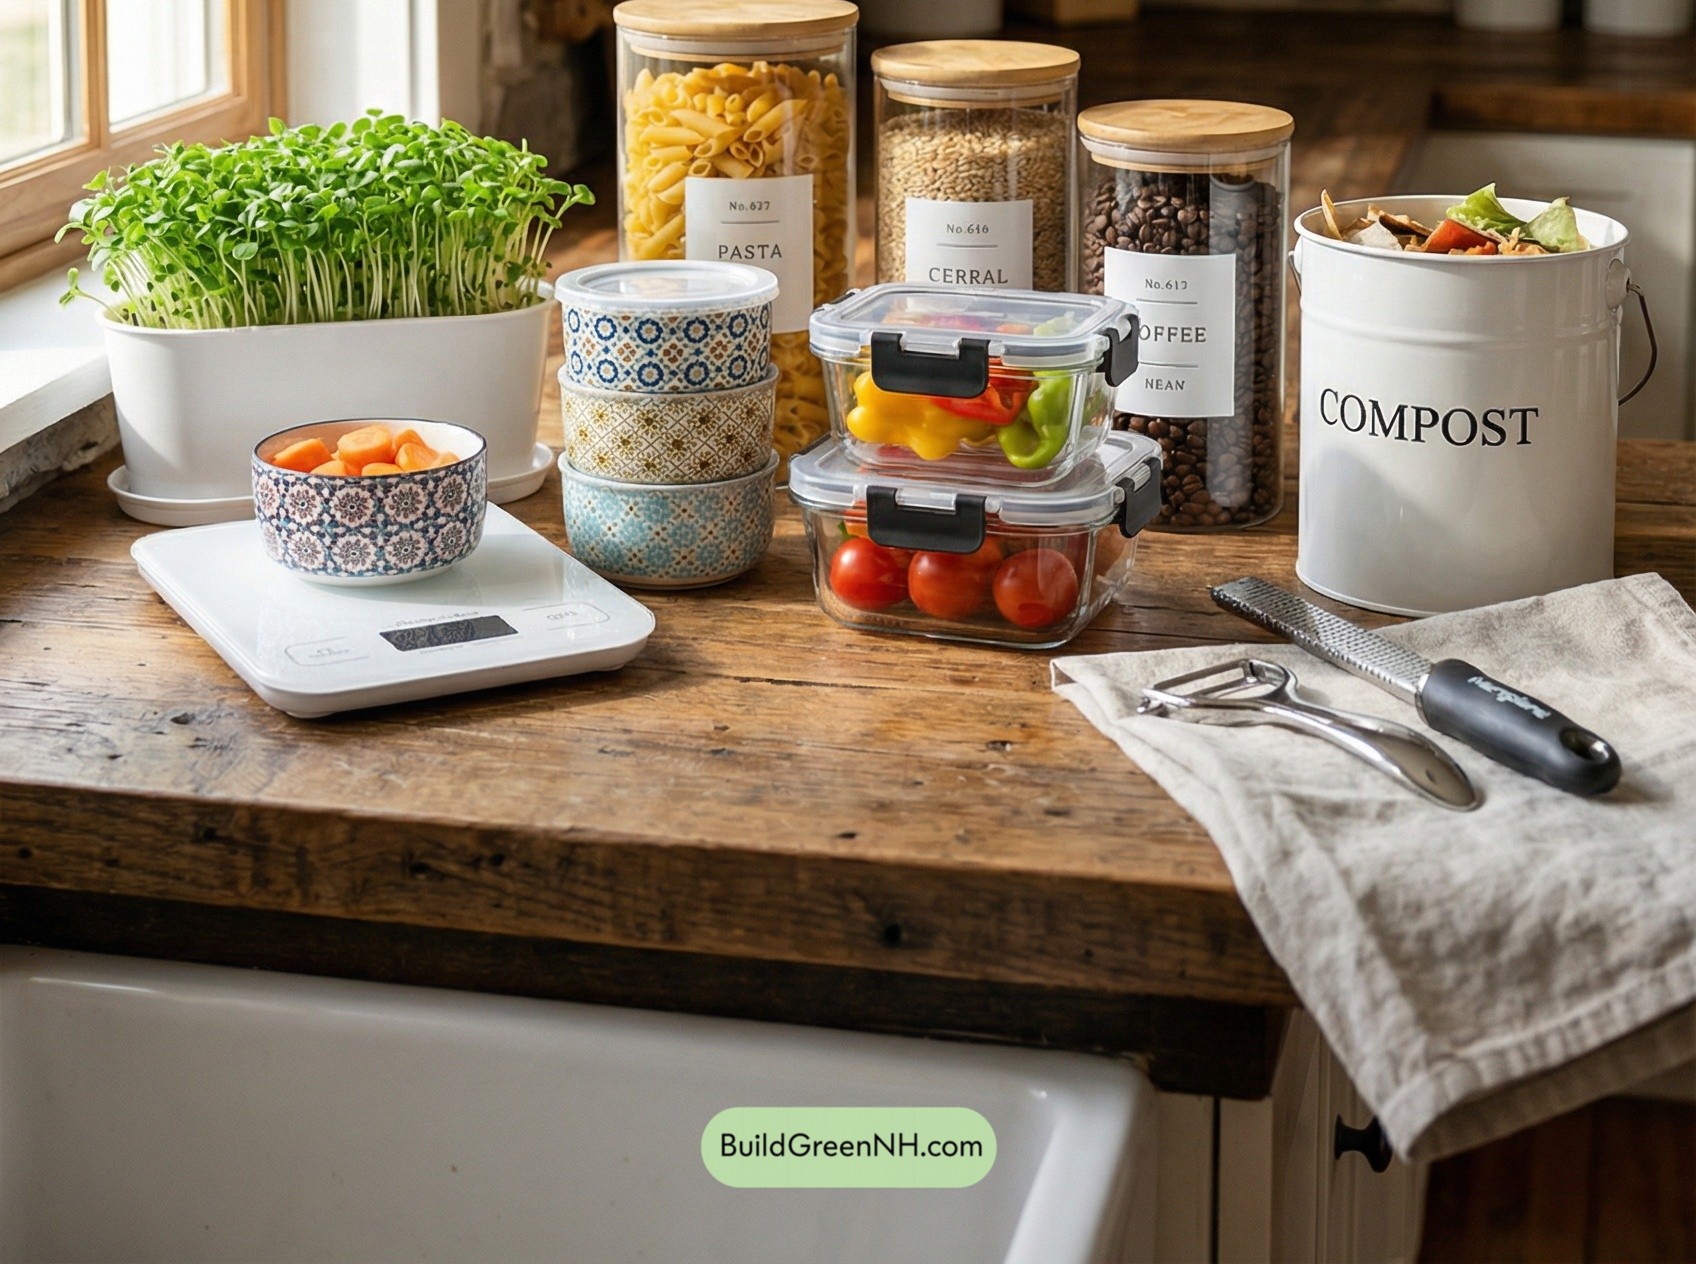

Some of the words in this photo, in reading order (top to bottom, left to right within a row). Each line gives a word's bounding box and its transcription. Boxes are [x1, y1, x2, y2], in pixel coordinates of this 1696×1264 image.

[718, 244, 782, 259] PASTA
[929, 267, 1008, 285] CERRAL
[1139, 324, 1207, 343] OFFEE
[1320, 388, 1539, 447] COMPOST
